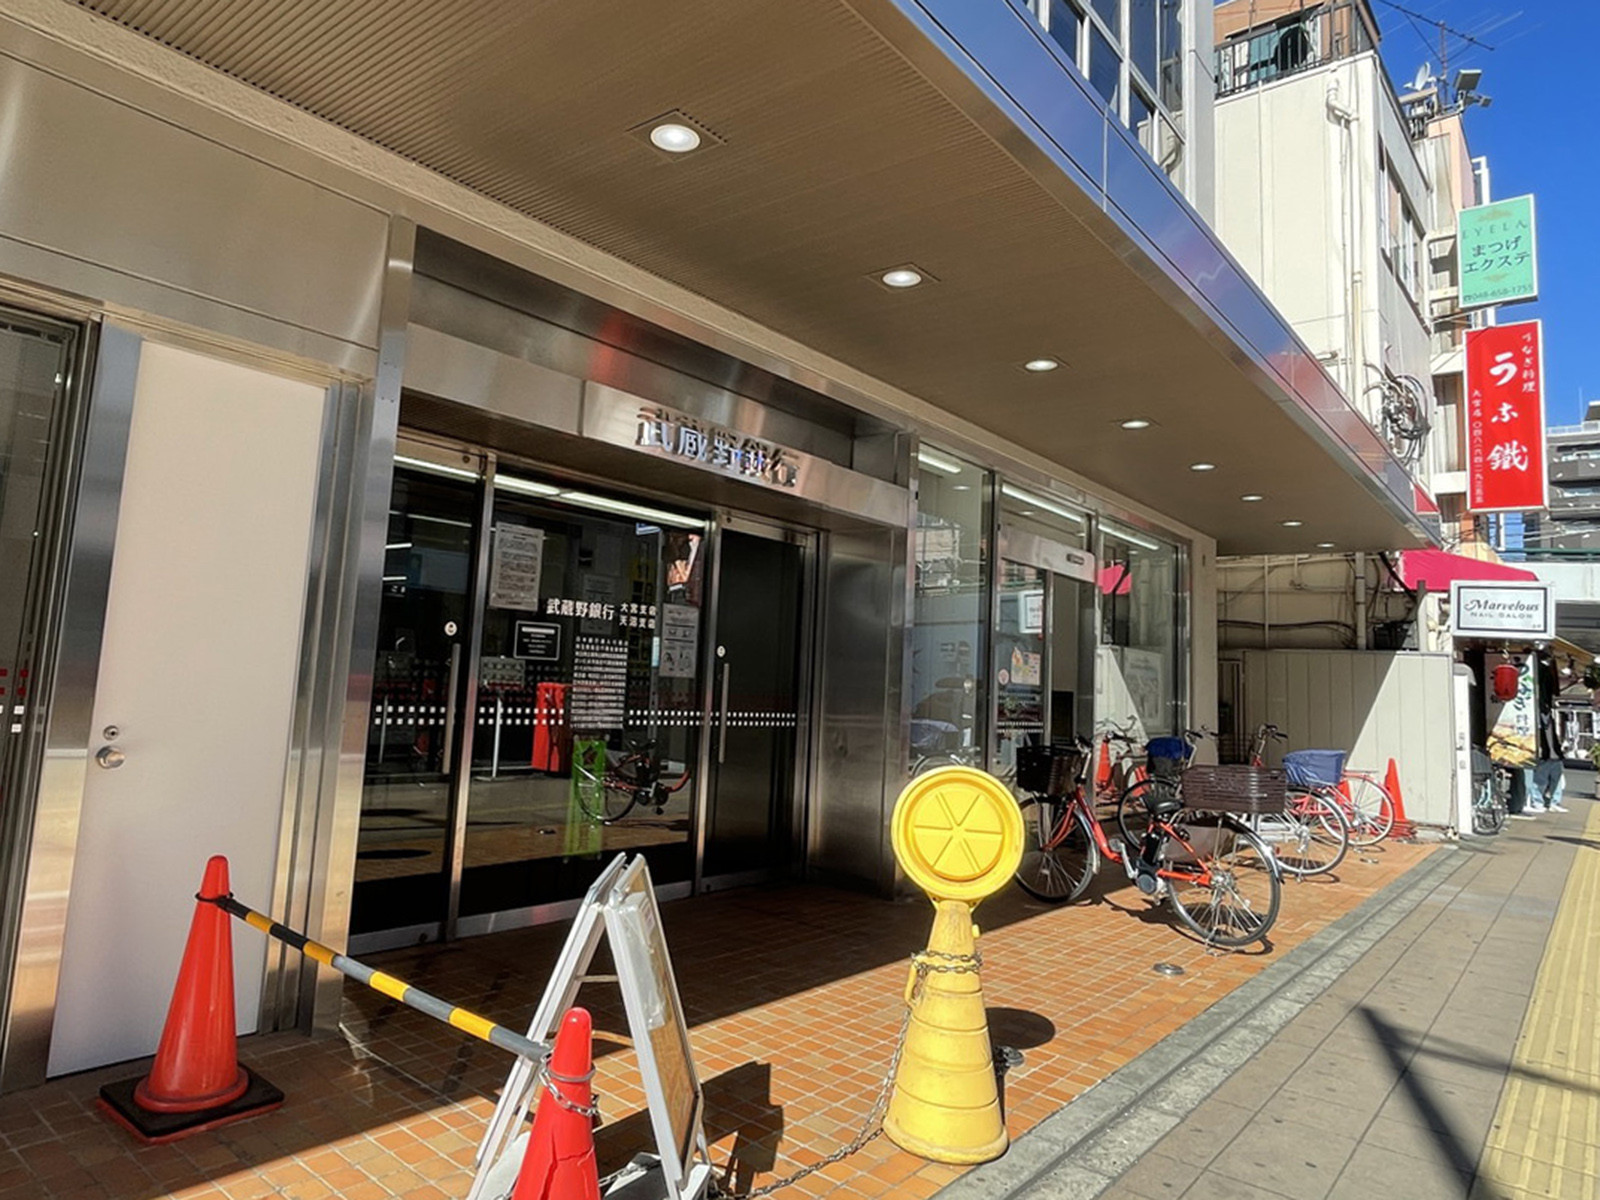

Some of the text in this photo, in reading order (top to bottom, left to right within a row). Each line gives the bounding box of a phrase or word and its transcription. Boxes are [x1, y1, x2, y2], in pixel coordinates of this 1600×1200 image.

[1472, 235, 1522, 258] まつげ
[1463, 251, 1530, 274] エクステ
[635, 406, 799, 487] 武蔵野銀行
[546, 598, 615, 621] 武蔵野銀行
[1464, 599, 1540, 612] Marvelous
[1470, 611, 1534, 620] NAIL SALON
